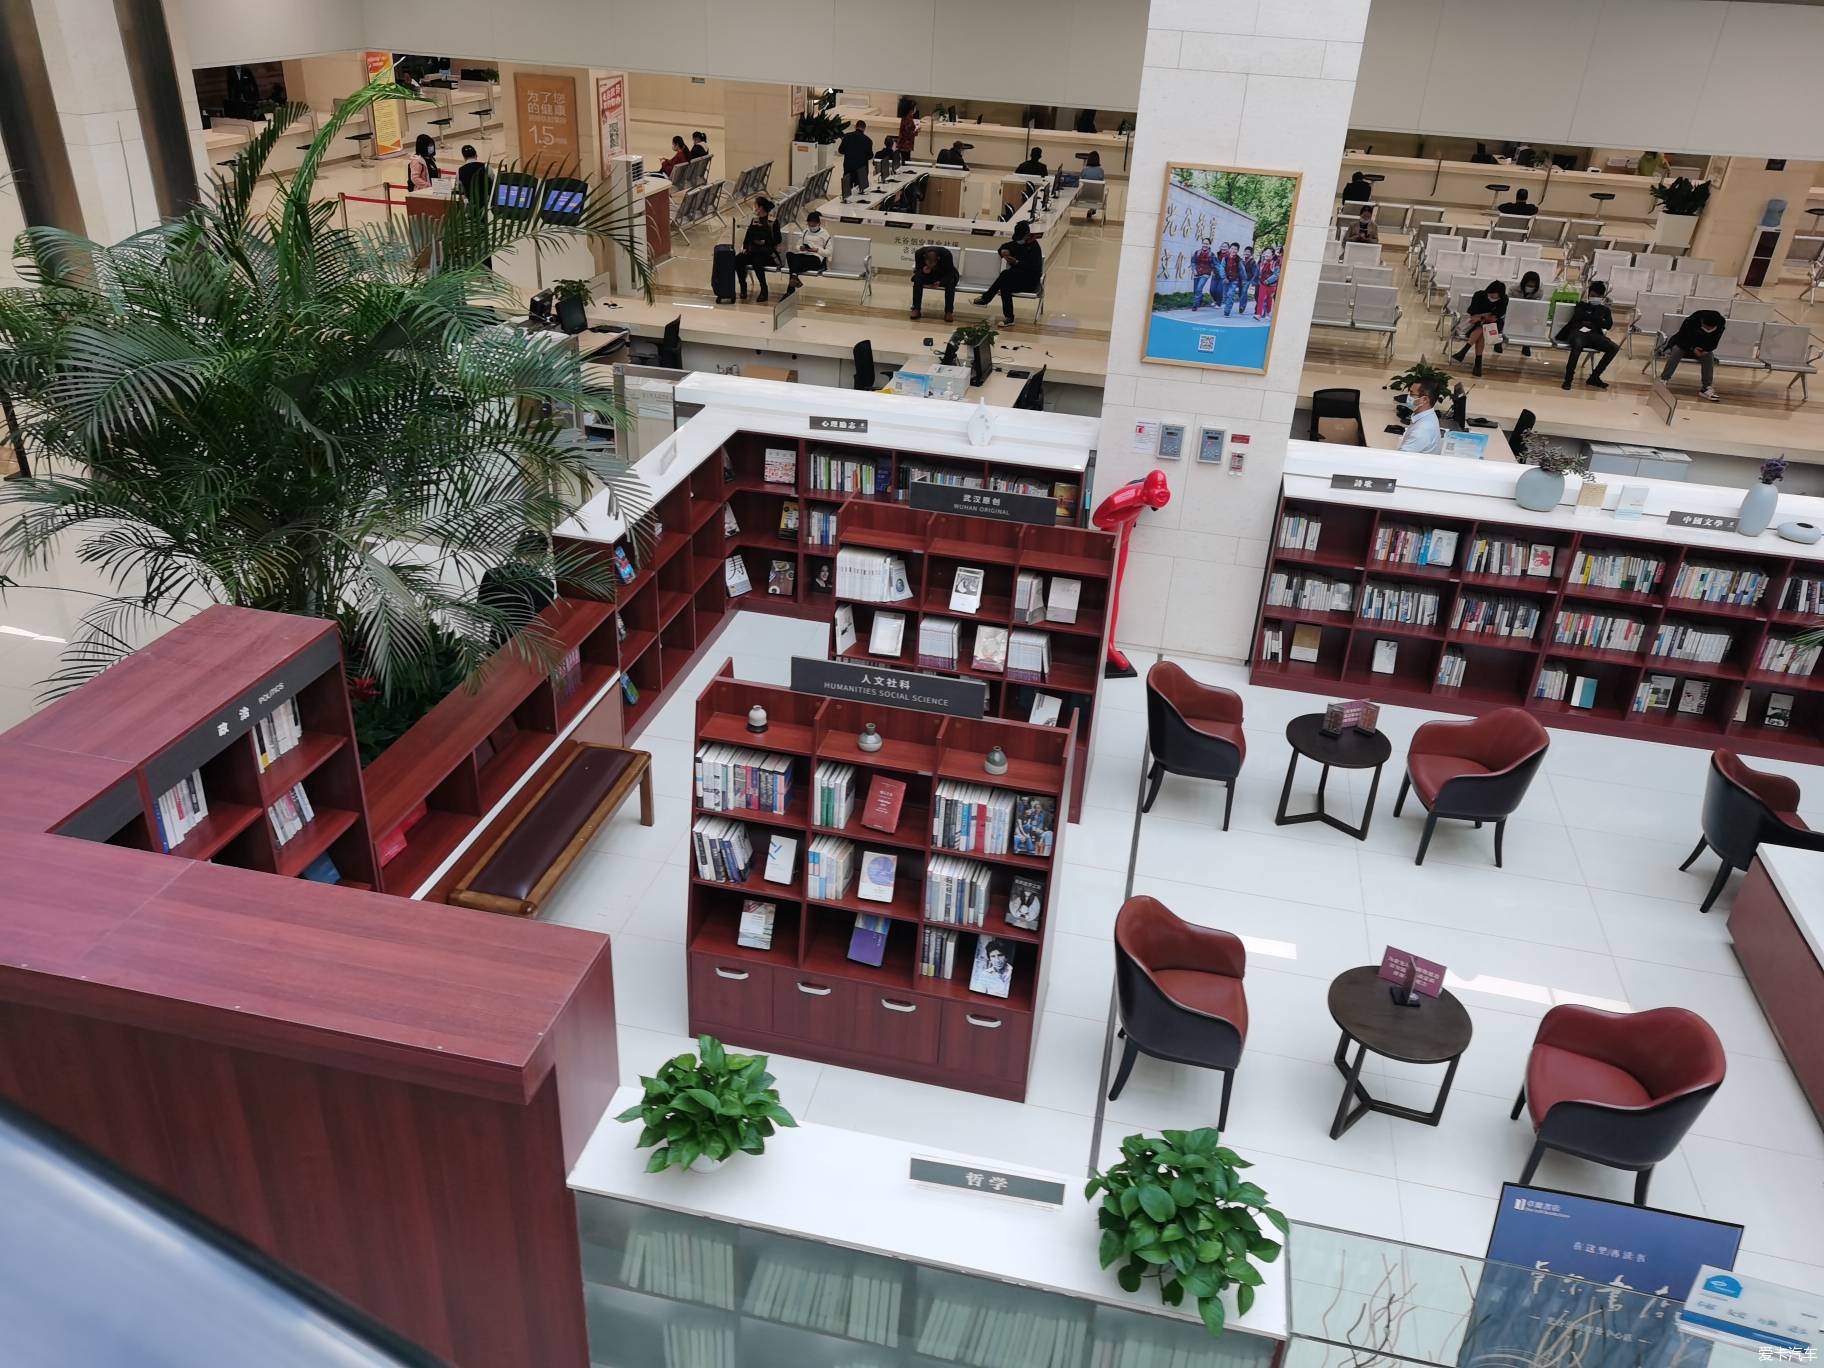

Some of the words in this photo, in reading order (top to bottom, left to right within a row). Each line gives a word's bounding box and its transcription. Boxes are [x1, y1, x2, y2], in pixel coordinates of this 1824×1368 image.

[527, 90, 566, 104] 为了您
[527, 103, 567, 117] 的健康
[529, 125, 555, 146] 1.5
[821, 420, 857, 429] 心理励志
[962, 493, 1001, 506] 武汉原创
[953, 503, 978, 512] WUHAN
[978, 506, 1010, 516] ORIGINAL
[1682, 515, 1724, 528] 中國文學
[860, 673, 912, 690] 人文社科
[258, 682, 285, 704] POLITICS
[823, 681, 878, 696] HUMANITIES
[878, 688, 911, 702] SOCIAL
[911, 694, 950, 708] SCIENCE
[965, 1171, 1008, 1191] 哲学
